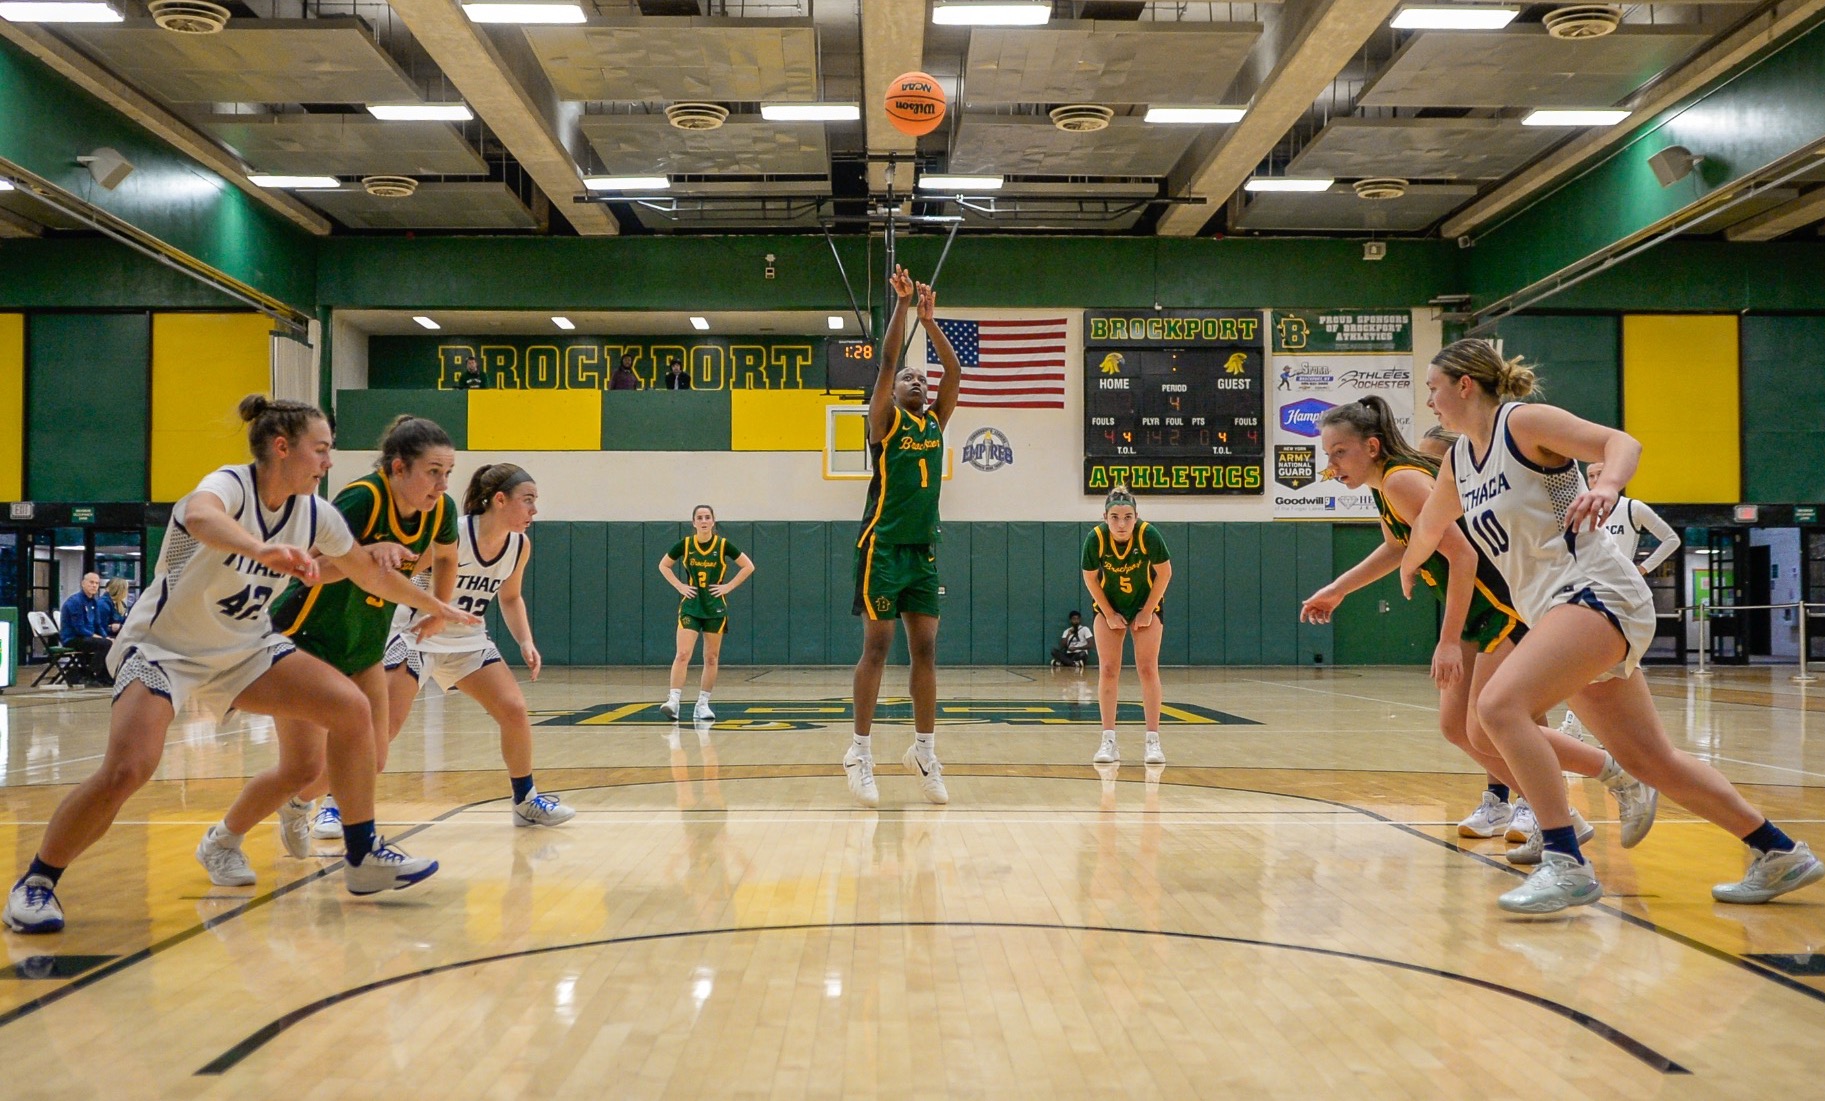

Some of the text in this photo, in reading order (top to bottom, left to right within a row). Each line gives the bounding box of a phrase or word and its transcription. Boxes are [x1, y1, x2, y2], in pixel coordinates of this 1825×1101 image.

[901, 82, 931, 92] NCAA
[896, 101, 935, 114] Wilson
[1319, 315, 1409, 324] PROUD SPONSORS
[1090, 317, 1258, 340] BROCKPORT
[1326, 324, 1403, 332] OF BROCKPORT
[1335, 332, 1393, 341] ATHLETICS
[845, 344, 873, 359] 1:28
[438, 345, 812, 390] BROCKPORT
[1099, 378, 1130, 390] HOME
[1161, 384, 1187, 393] PERIOD
[1217, 378, 1251, 390] GUEST
[1338, 379, 1411, 389] ROCHESTER
[1169, 396, 1180, 411] 4
[1091, 417, 1115, 426] FOULS
[1142, 417, 1205, 426] PLYR FOUL PTS
[1234, 417, 1258, 426] FOULS
[1104, 429, 1116, 444] 4
[1122, 431, 1132, 443] 4
[1218, 431, 1227, 443] 4
[1247, 429, 1258, 444] 4
[1117, 446, 1137, 455] T.O.L.
[1212, 446, 1232, 455] T.O.L.
[1279, 453, 1311, 462] ARMY
[918, 458, 928, 488] 1
[1089, 465, 1260, 488] ATHLETICS
[1278, 468, 1312, 476] GUARD
[1275, 497, 1324, 505] Goodwill
[1472, 509, 1510, 557] 10
[456, 575, 502, 593] THAC
[697, 571, 707, 588] 2
[1119, 575, 1133, 594] 5
[216, 584, 273, 620] 42
